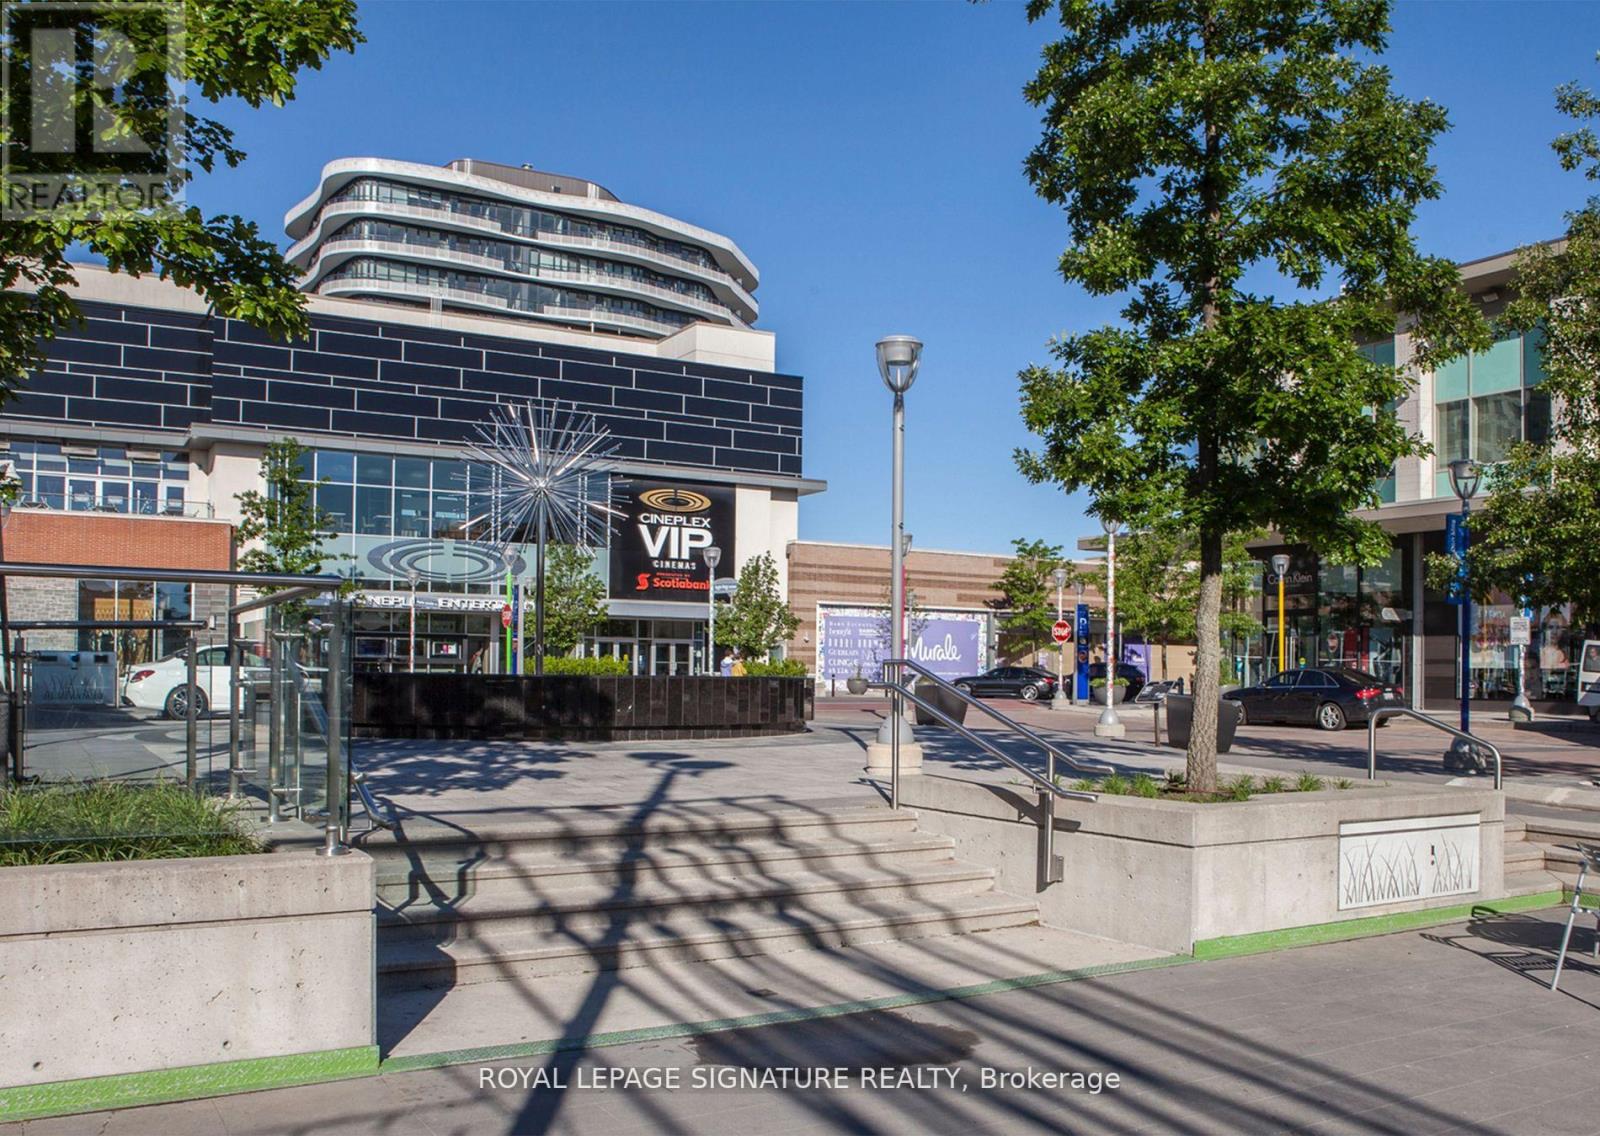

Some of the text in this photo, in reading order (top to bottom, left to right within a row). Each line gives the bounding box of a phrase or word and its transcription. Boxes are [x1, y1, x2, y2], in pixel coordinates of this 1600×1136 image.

[638, 513, 711, 528] CINEPLEX
[637, 523, 713, 560] VIP
[652, 560, 697, 570] CINEMAS
